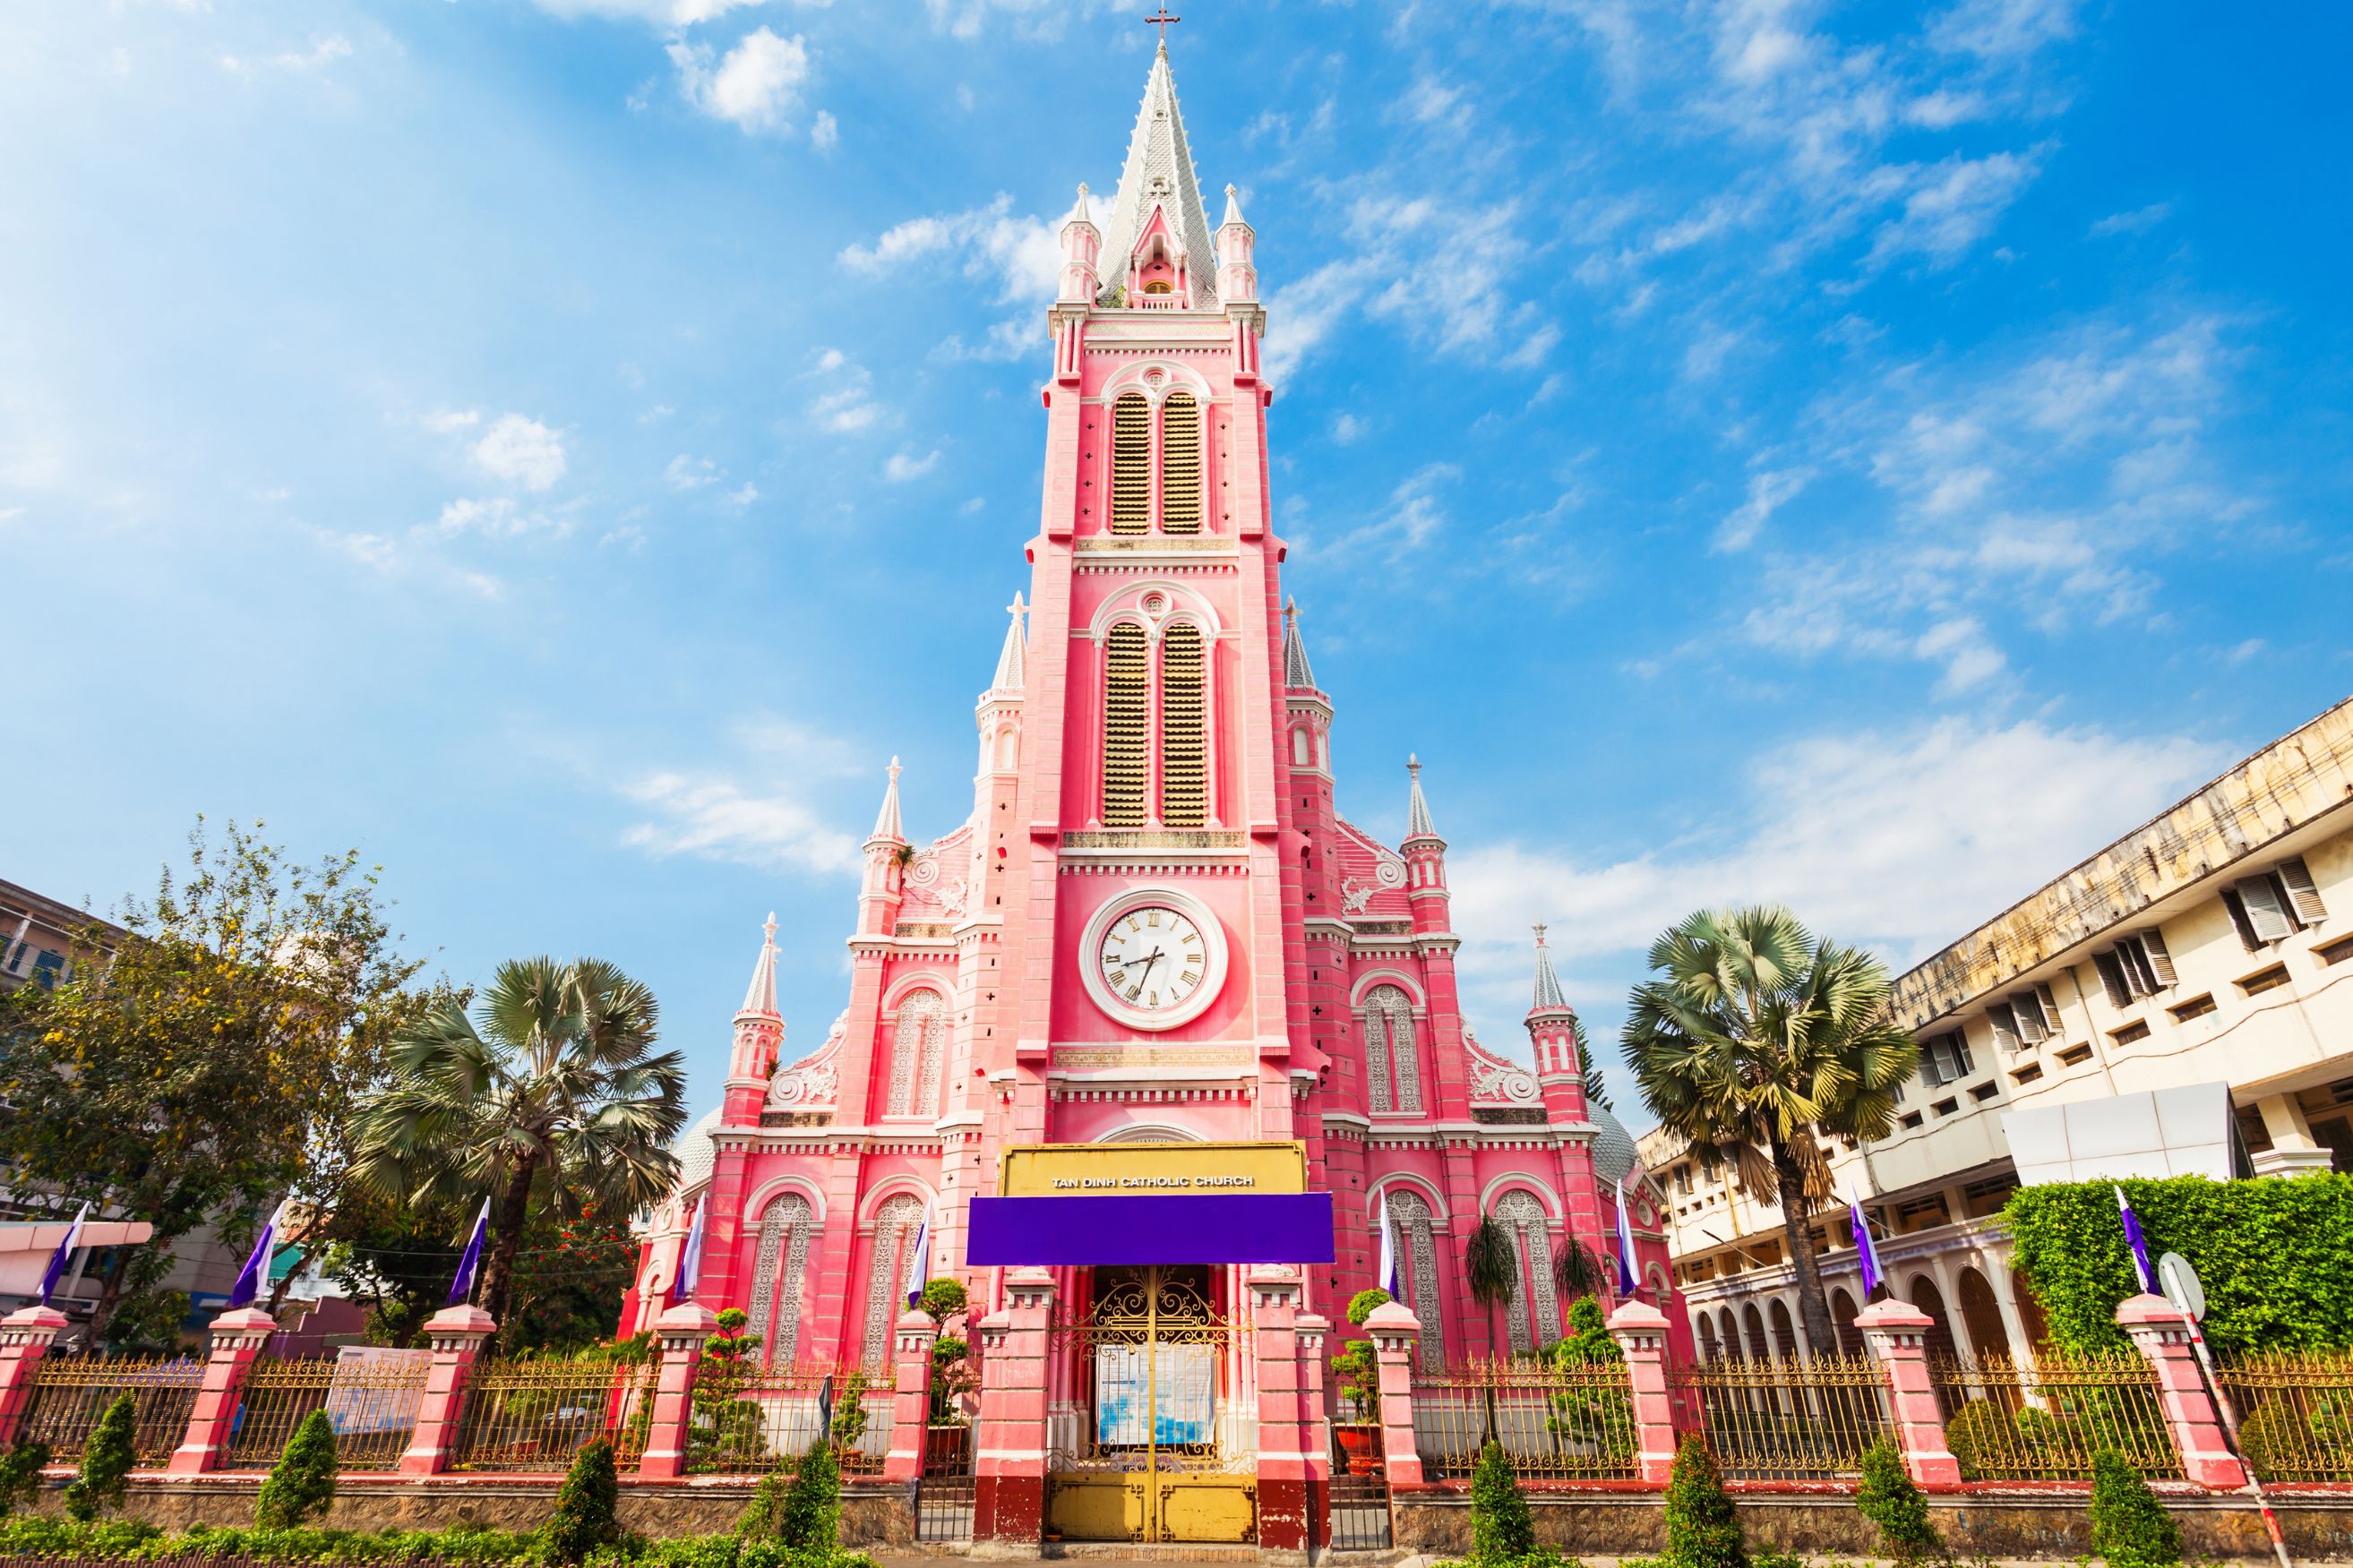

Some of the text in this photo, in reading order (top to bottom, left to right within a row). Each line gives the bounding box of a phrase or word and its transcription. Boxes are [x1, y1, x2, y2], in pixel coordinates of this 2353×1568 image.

[1127, 917, 1140, 932] XI
[1147, 913, 1161, 927] XII
[1181, 933, 1196, 945] II
[1187, 954, 1201, 963] III
[1109, 970, 1127, 988] VIII
[1052, 1176, 1255, 1188] TAN DINH CATHOLIC CHURCH
